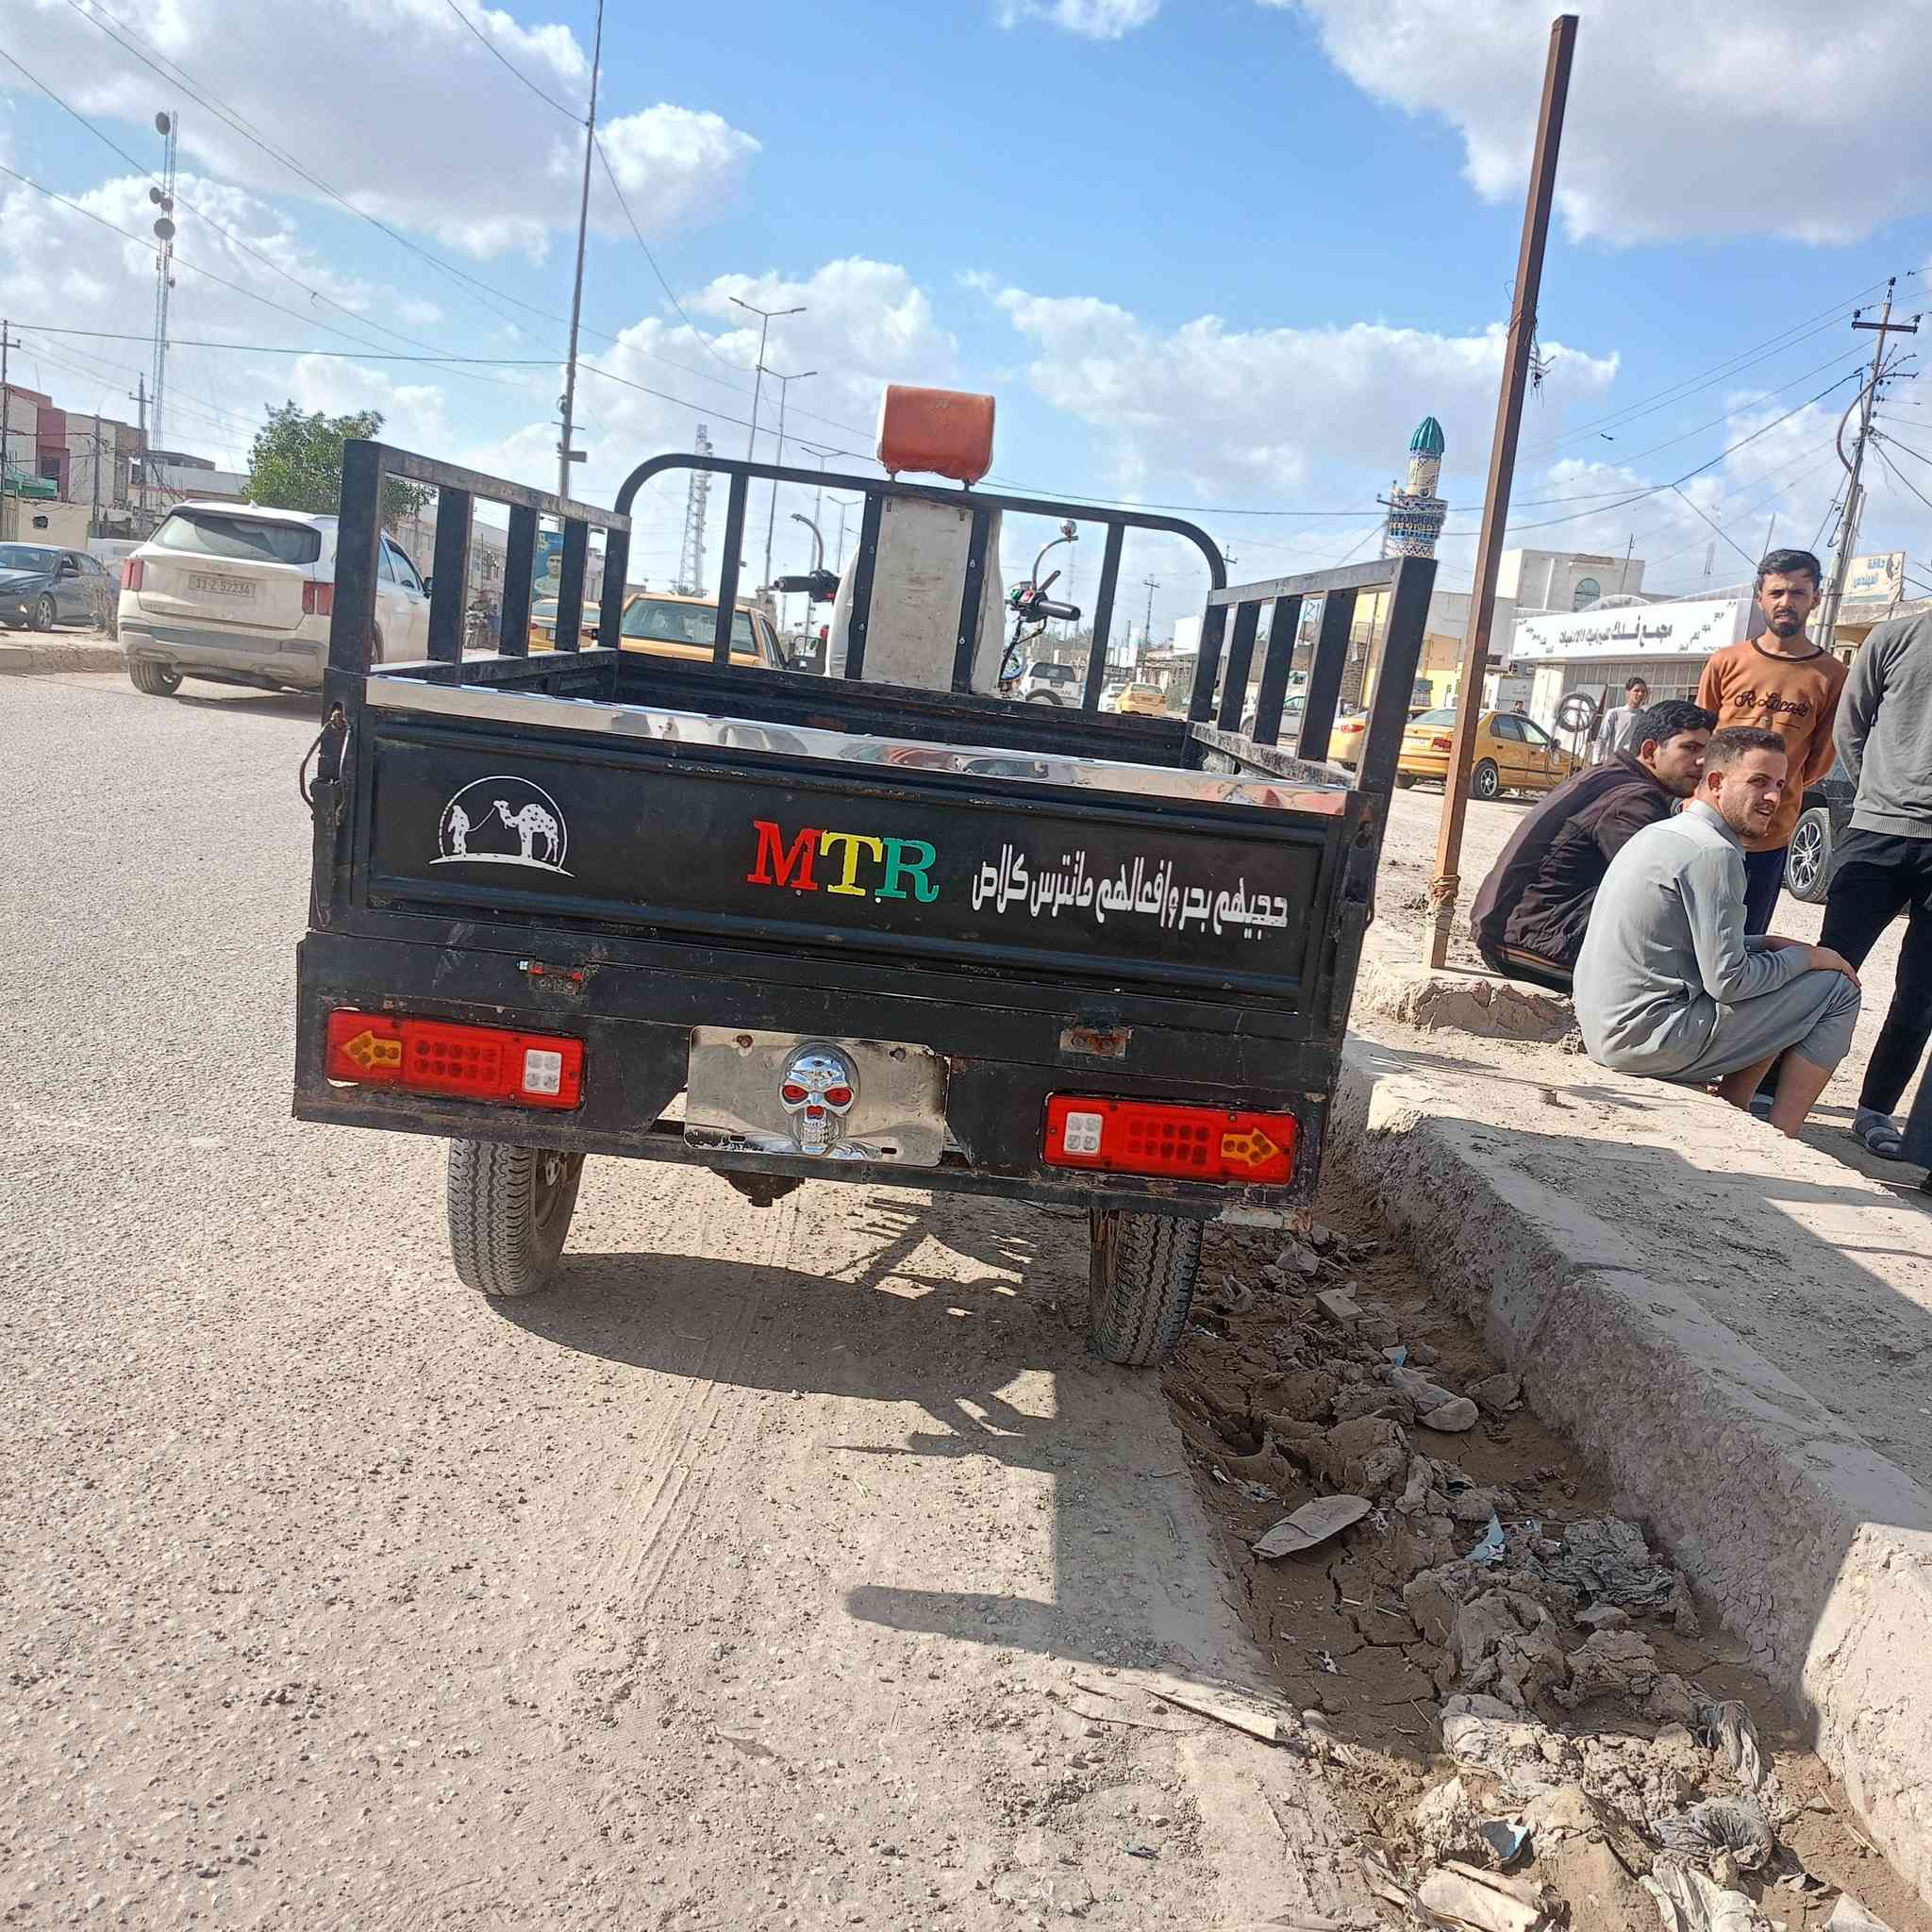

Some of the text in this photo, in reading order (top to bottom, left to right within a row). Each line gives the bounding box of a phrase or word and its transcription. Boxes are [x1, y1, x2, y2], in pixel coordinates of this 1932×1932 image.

[746, 819, 940, 904] MTR
[972, 843, 1029, 914] كلاص
[1178, 885, 1213, 933] بحر
[1213, 876, 1289, 941] حجيهم
